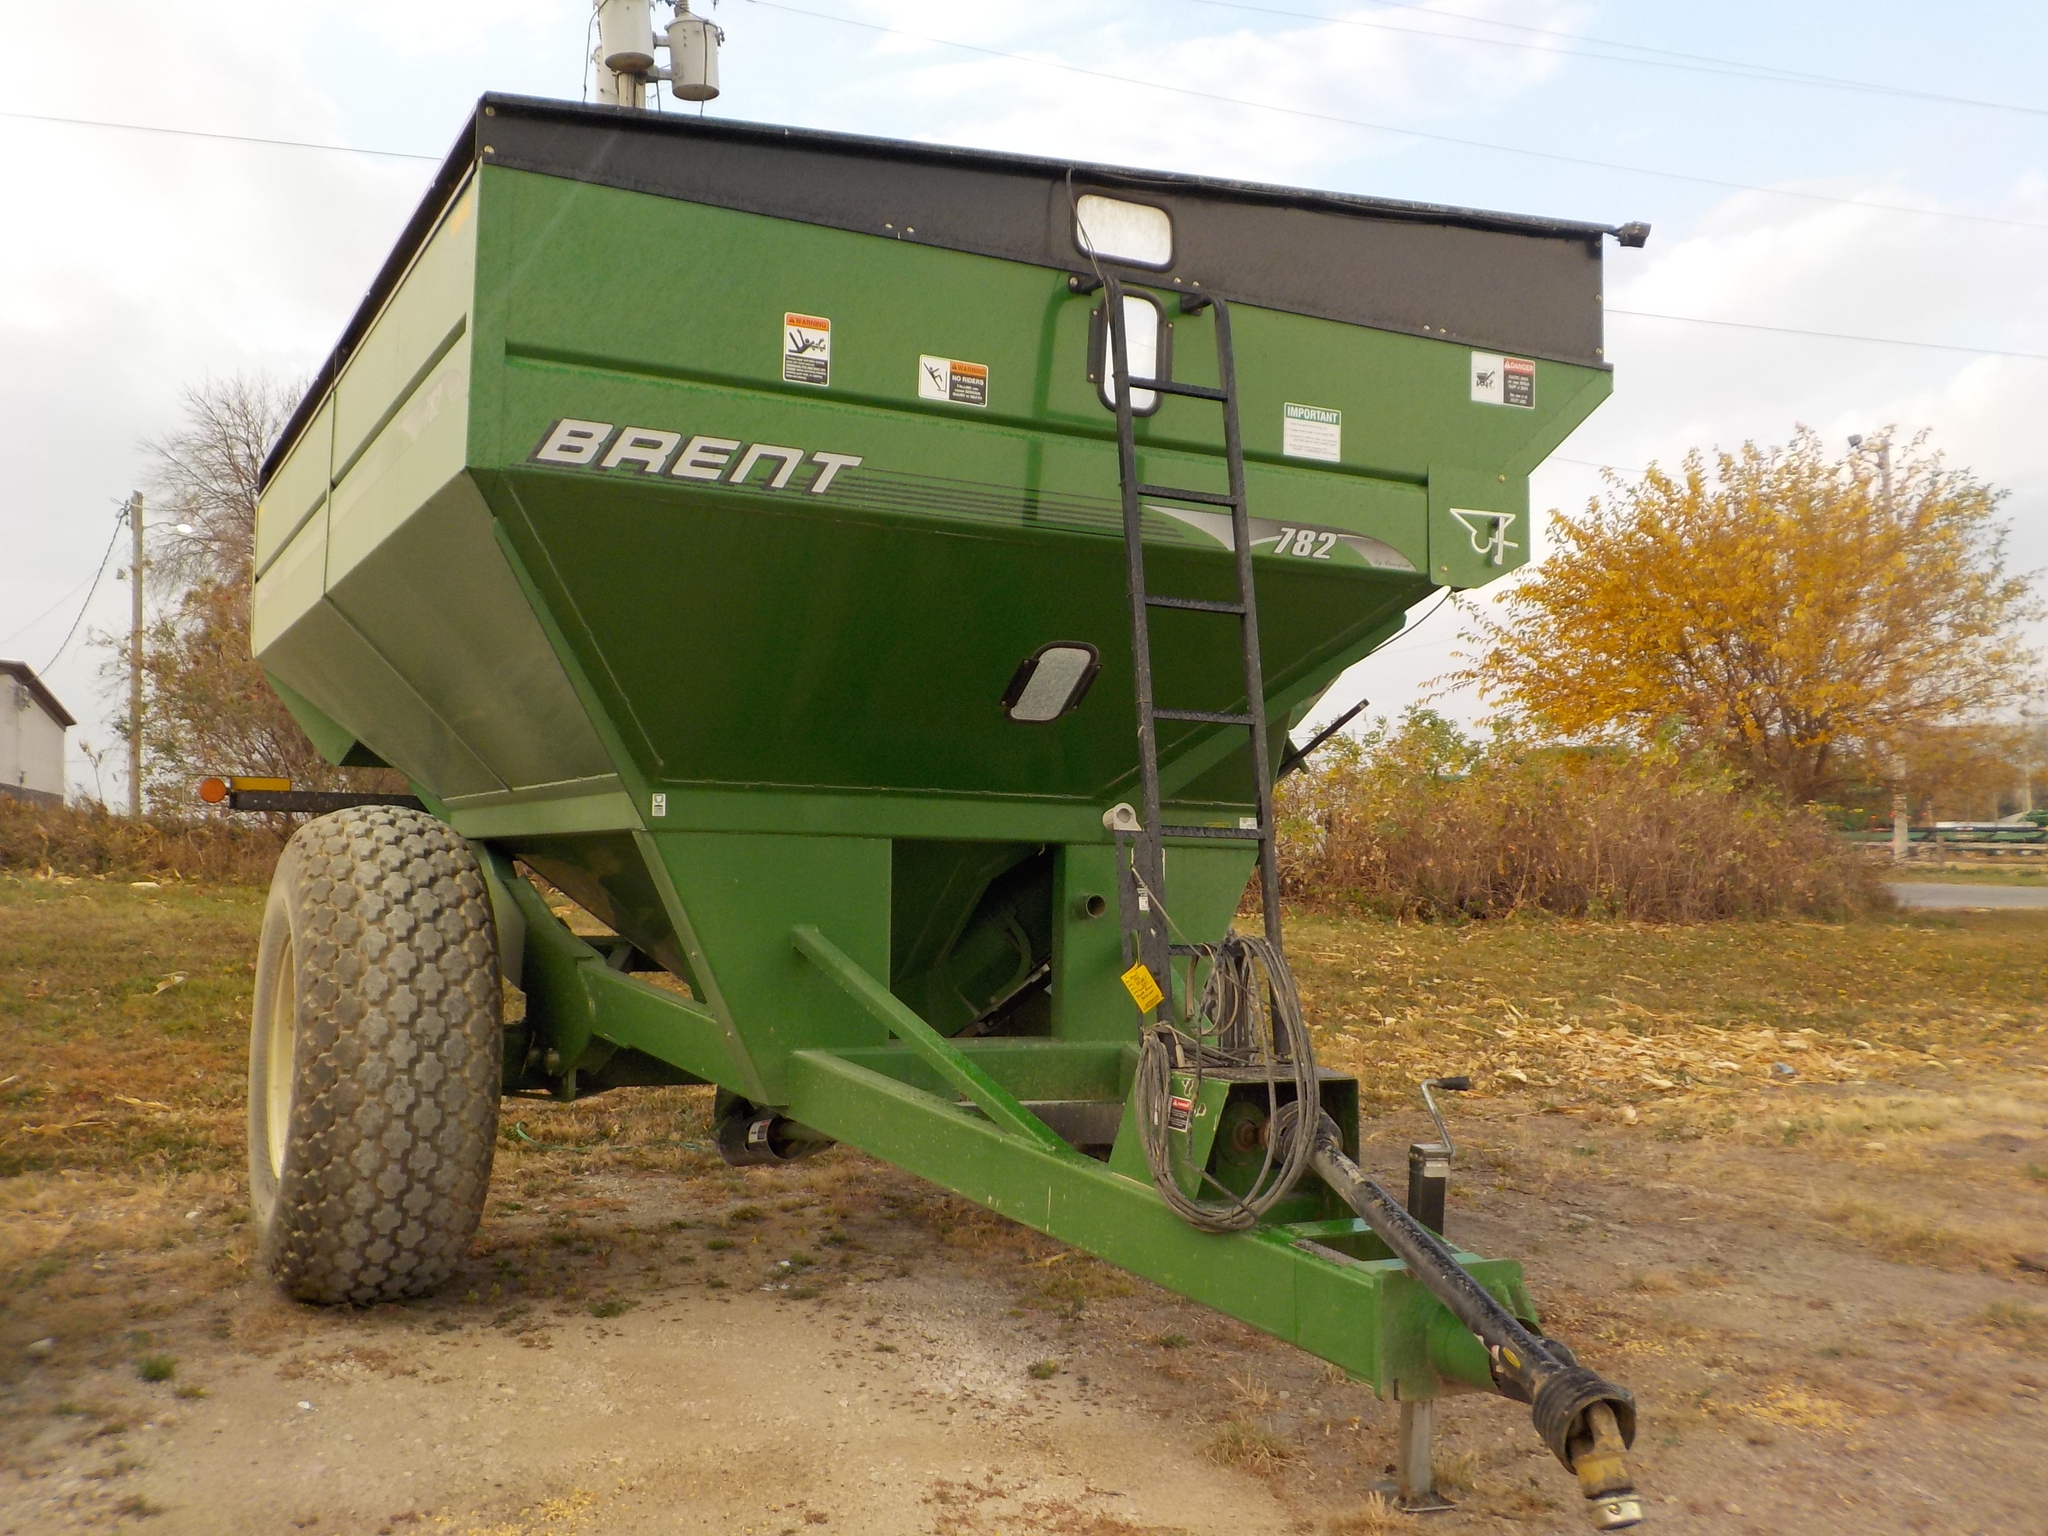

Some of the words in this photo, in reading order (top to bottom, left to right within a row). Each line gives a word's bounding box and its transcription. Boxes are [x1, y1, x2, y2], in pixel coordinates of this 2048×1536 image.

[796, 317, 827, 329] WARNING
[958, 365, 985, 374] WARNING
[1511, 362, 1533, 371] DANGER
[962, 376, 984, 385] RIDERS
[1287, 405, 1338, 423] IMPORTANT
[532, 417, 864, 495] BRENT
[1272, 526, 1338, 560] 782
